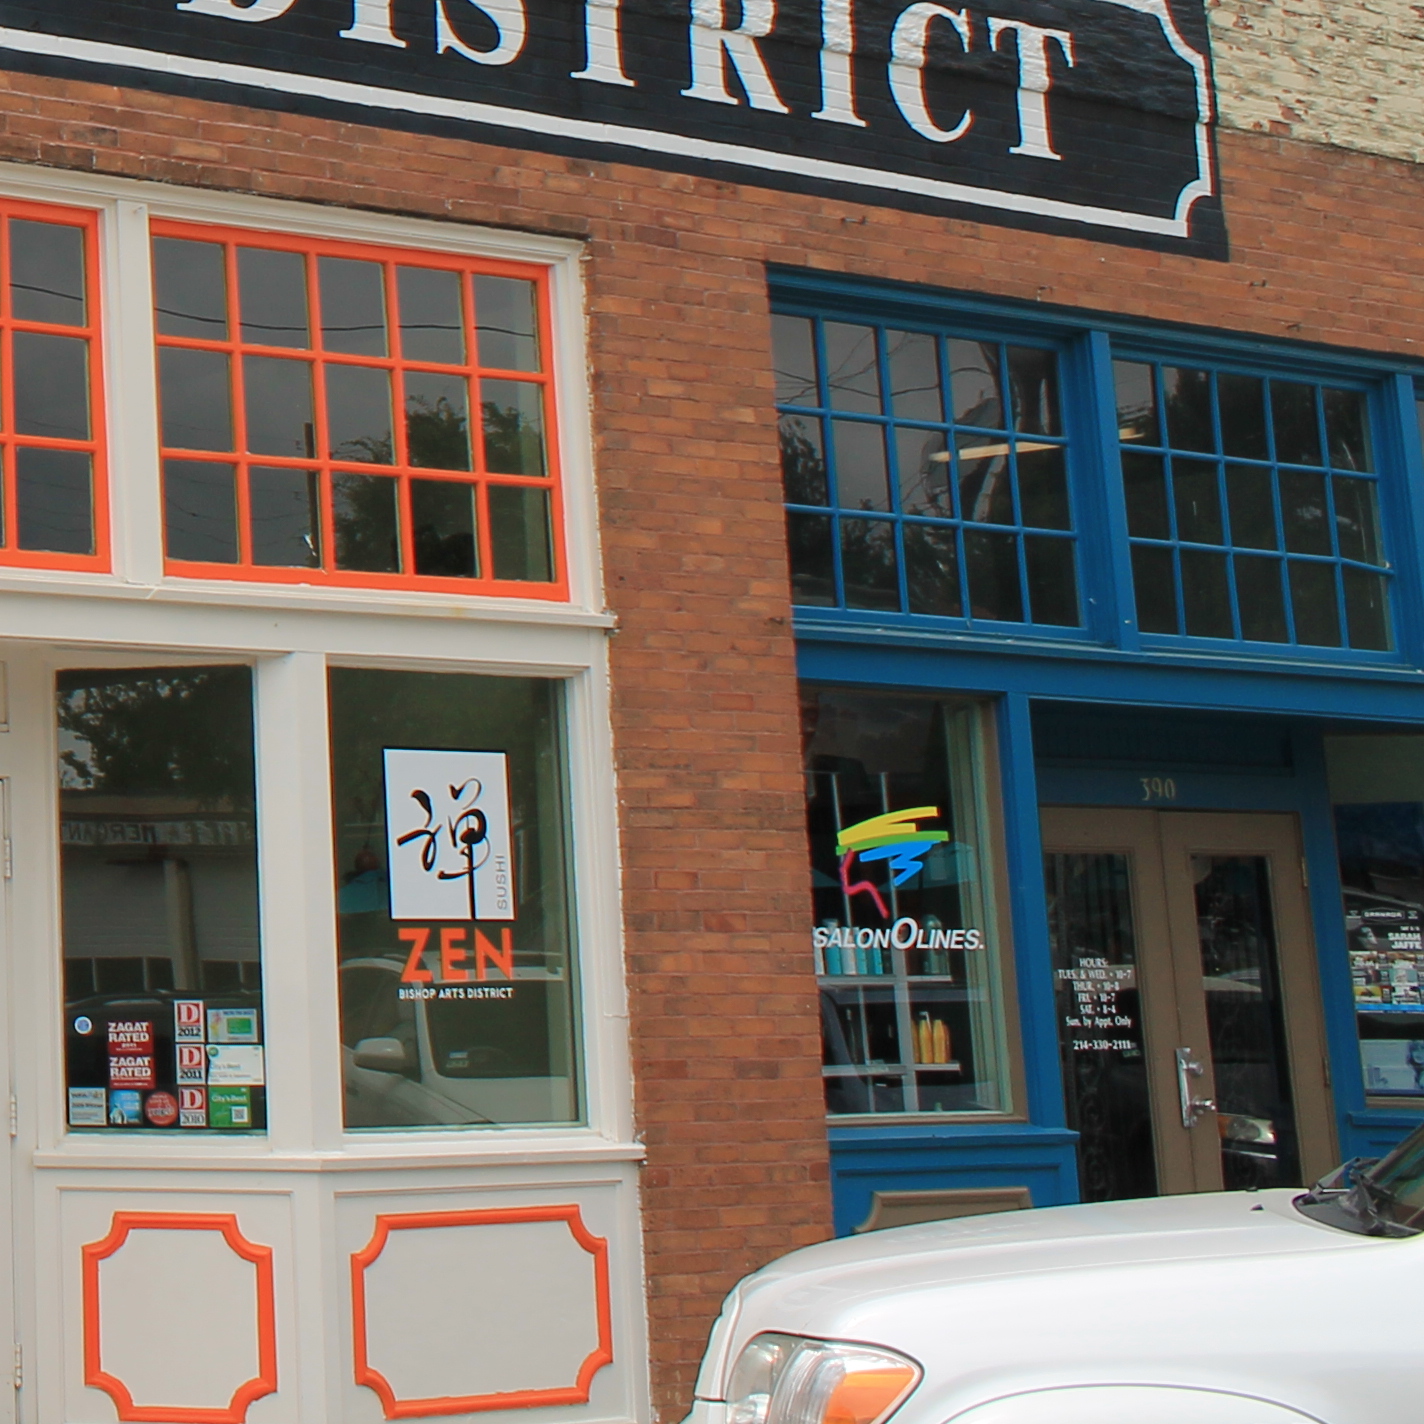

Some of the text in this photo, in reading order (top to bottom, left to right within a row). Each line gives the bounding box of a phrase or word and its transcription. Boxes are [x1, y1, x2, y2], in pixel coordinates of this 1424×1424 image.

[1140, 777, 1176, 801] 390
[496, 855, 508, 910] SUSHI
[1388, 932, 1421, 941] SARAH
[1391, 941, 1422, 949] JAFFE
[398, 927, 513, 983] ZEN
[1079, 958, 1109, 967] HOURS:
[1080, 970, 1086, 979] &
[398, 987, 513, 1000] BISHOP ARTS DISTRICT
[179, 1003, 199, 1023] D
[1083, 1016, 1091, 1028] by
[1115, 1015, 1131, 1028] Only
[108, 1022, 149, 1032] ZAGAT
[178, 1027, 201, 1037] 2012
[108, 1032, 149, 1042] RATED
[1073, 1040, 1131, 1050] 214-330-2111
[181, 1047, 201, 1065] D
[109, 1057, 151, 1066] ZAGAT
[110, 1067, 151, 1077] RATED
[180, 1069, 202, 1079] 2011
[182, 1089, 203, 1109] D
[181, 1114, 205, 1124] 2010
